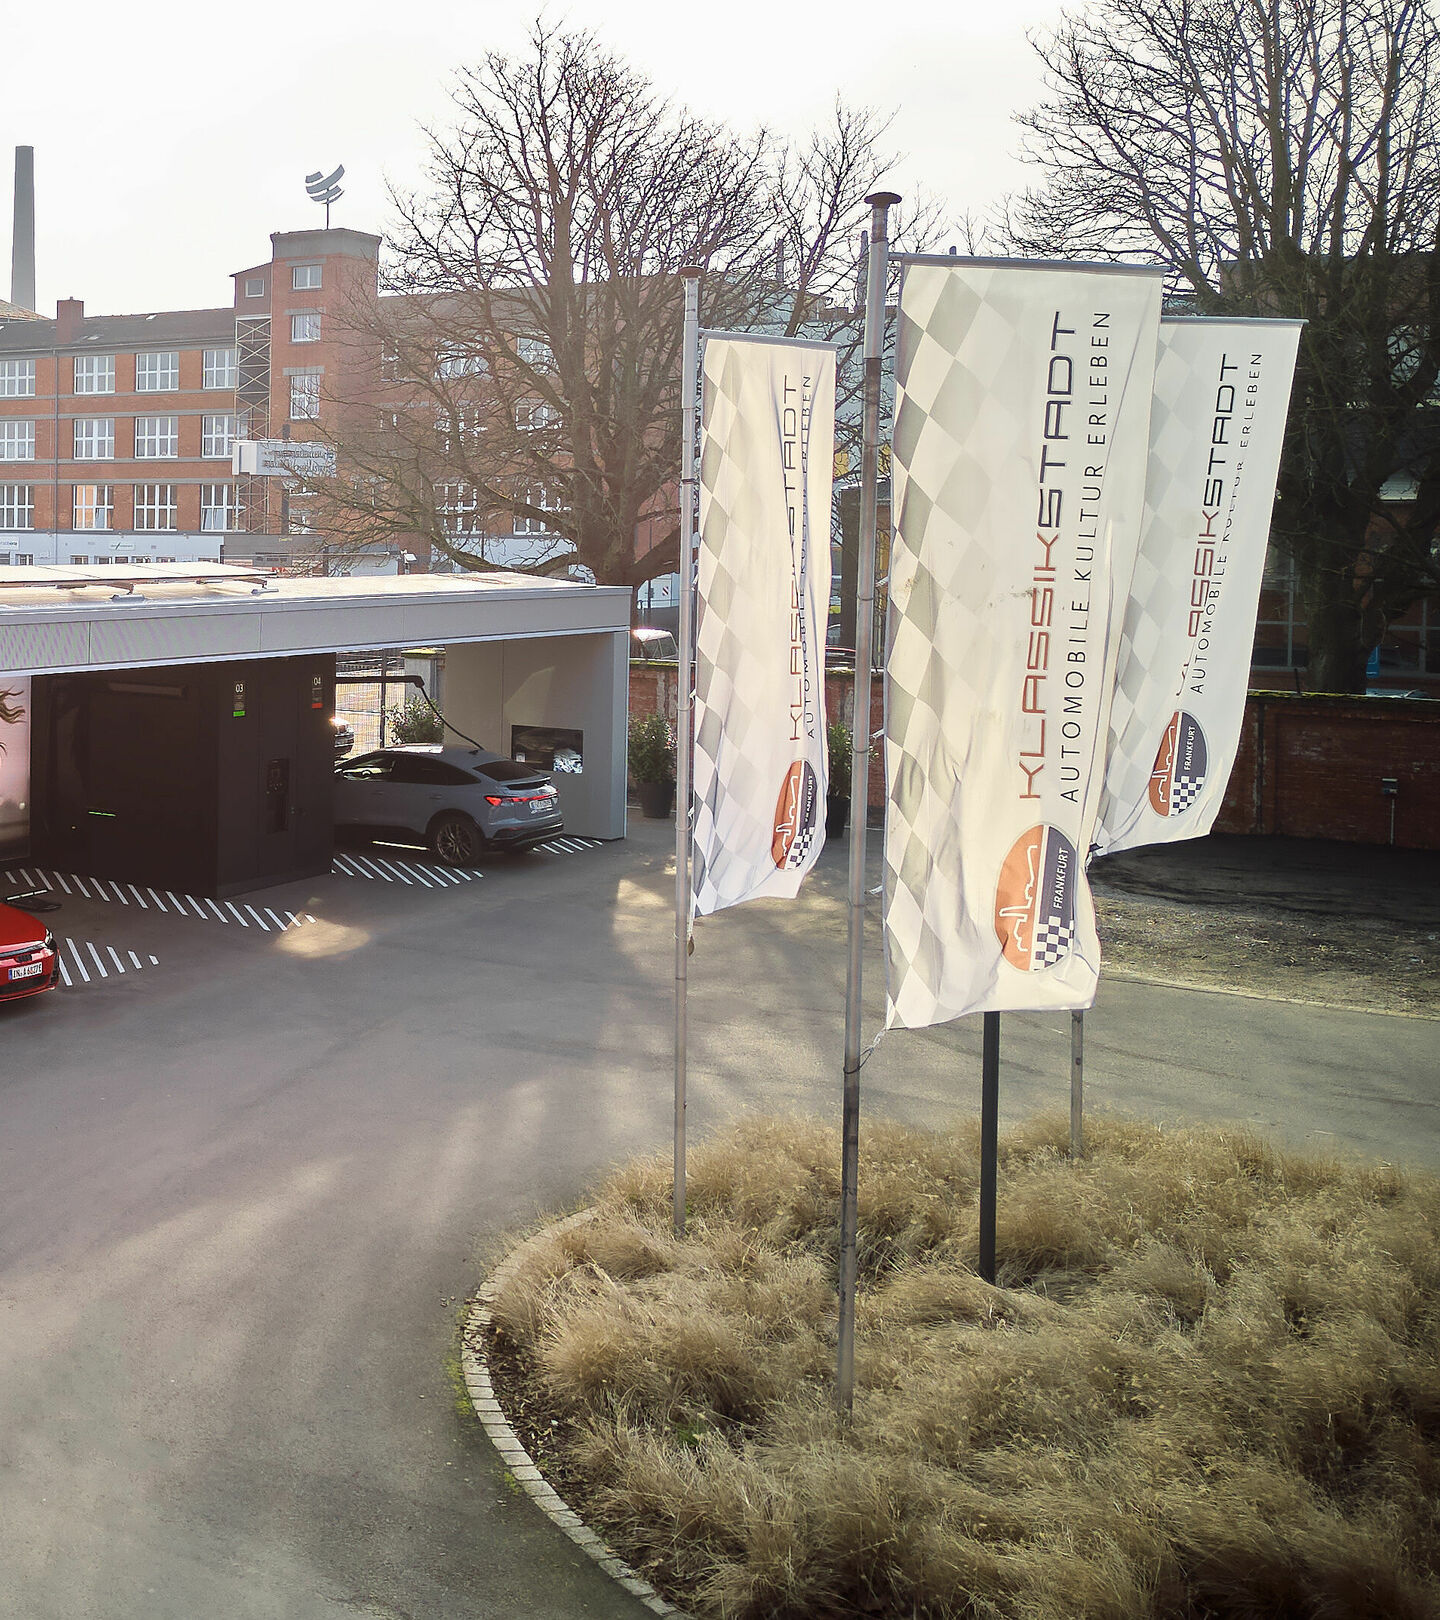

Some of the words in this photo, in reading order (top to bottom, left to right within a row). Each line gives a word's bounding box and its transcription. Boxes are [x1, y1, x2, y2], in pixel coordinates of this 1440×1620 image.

[1087, 311, 1111, 446] ERLEBEN
[1018, 310, 1078, 800] KLASSIKSTADT
[1073, 463, 1104, 582] KULTUR
[1175, 353, 1239, 697] ASSIKSTADT
[1190, 555, 1227, 695] AUTOMOBILE
[1240, 353, 1263, 449] ERLEBEN
[235, 683, 244, 693] 03
[313, 677, 321, 686] 04
[1060, 600, 1090, 803] AUTOMOBILE
[1183, 726, 1197, 771] FRANKFURT
[1053, 848, 1070, 909] FRANKFURT
